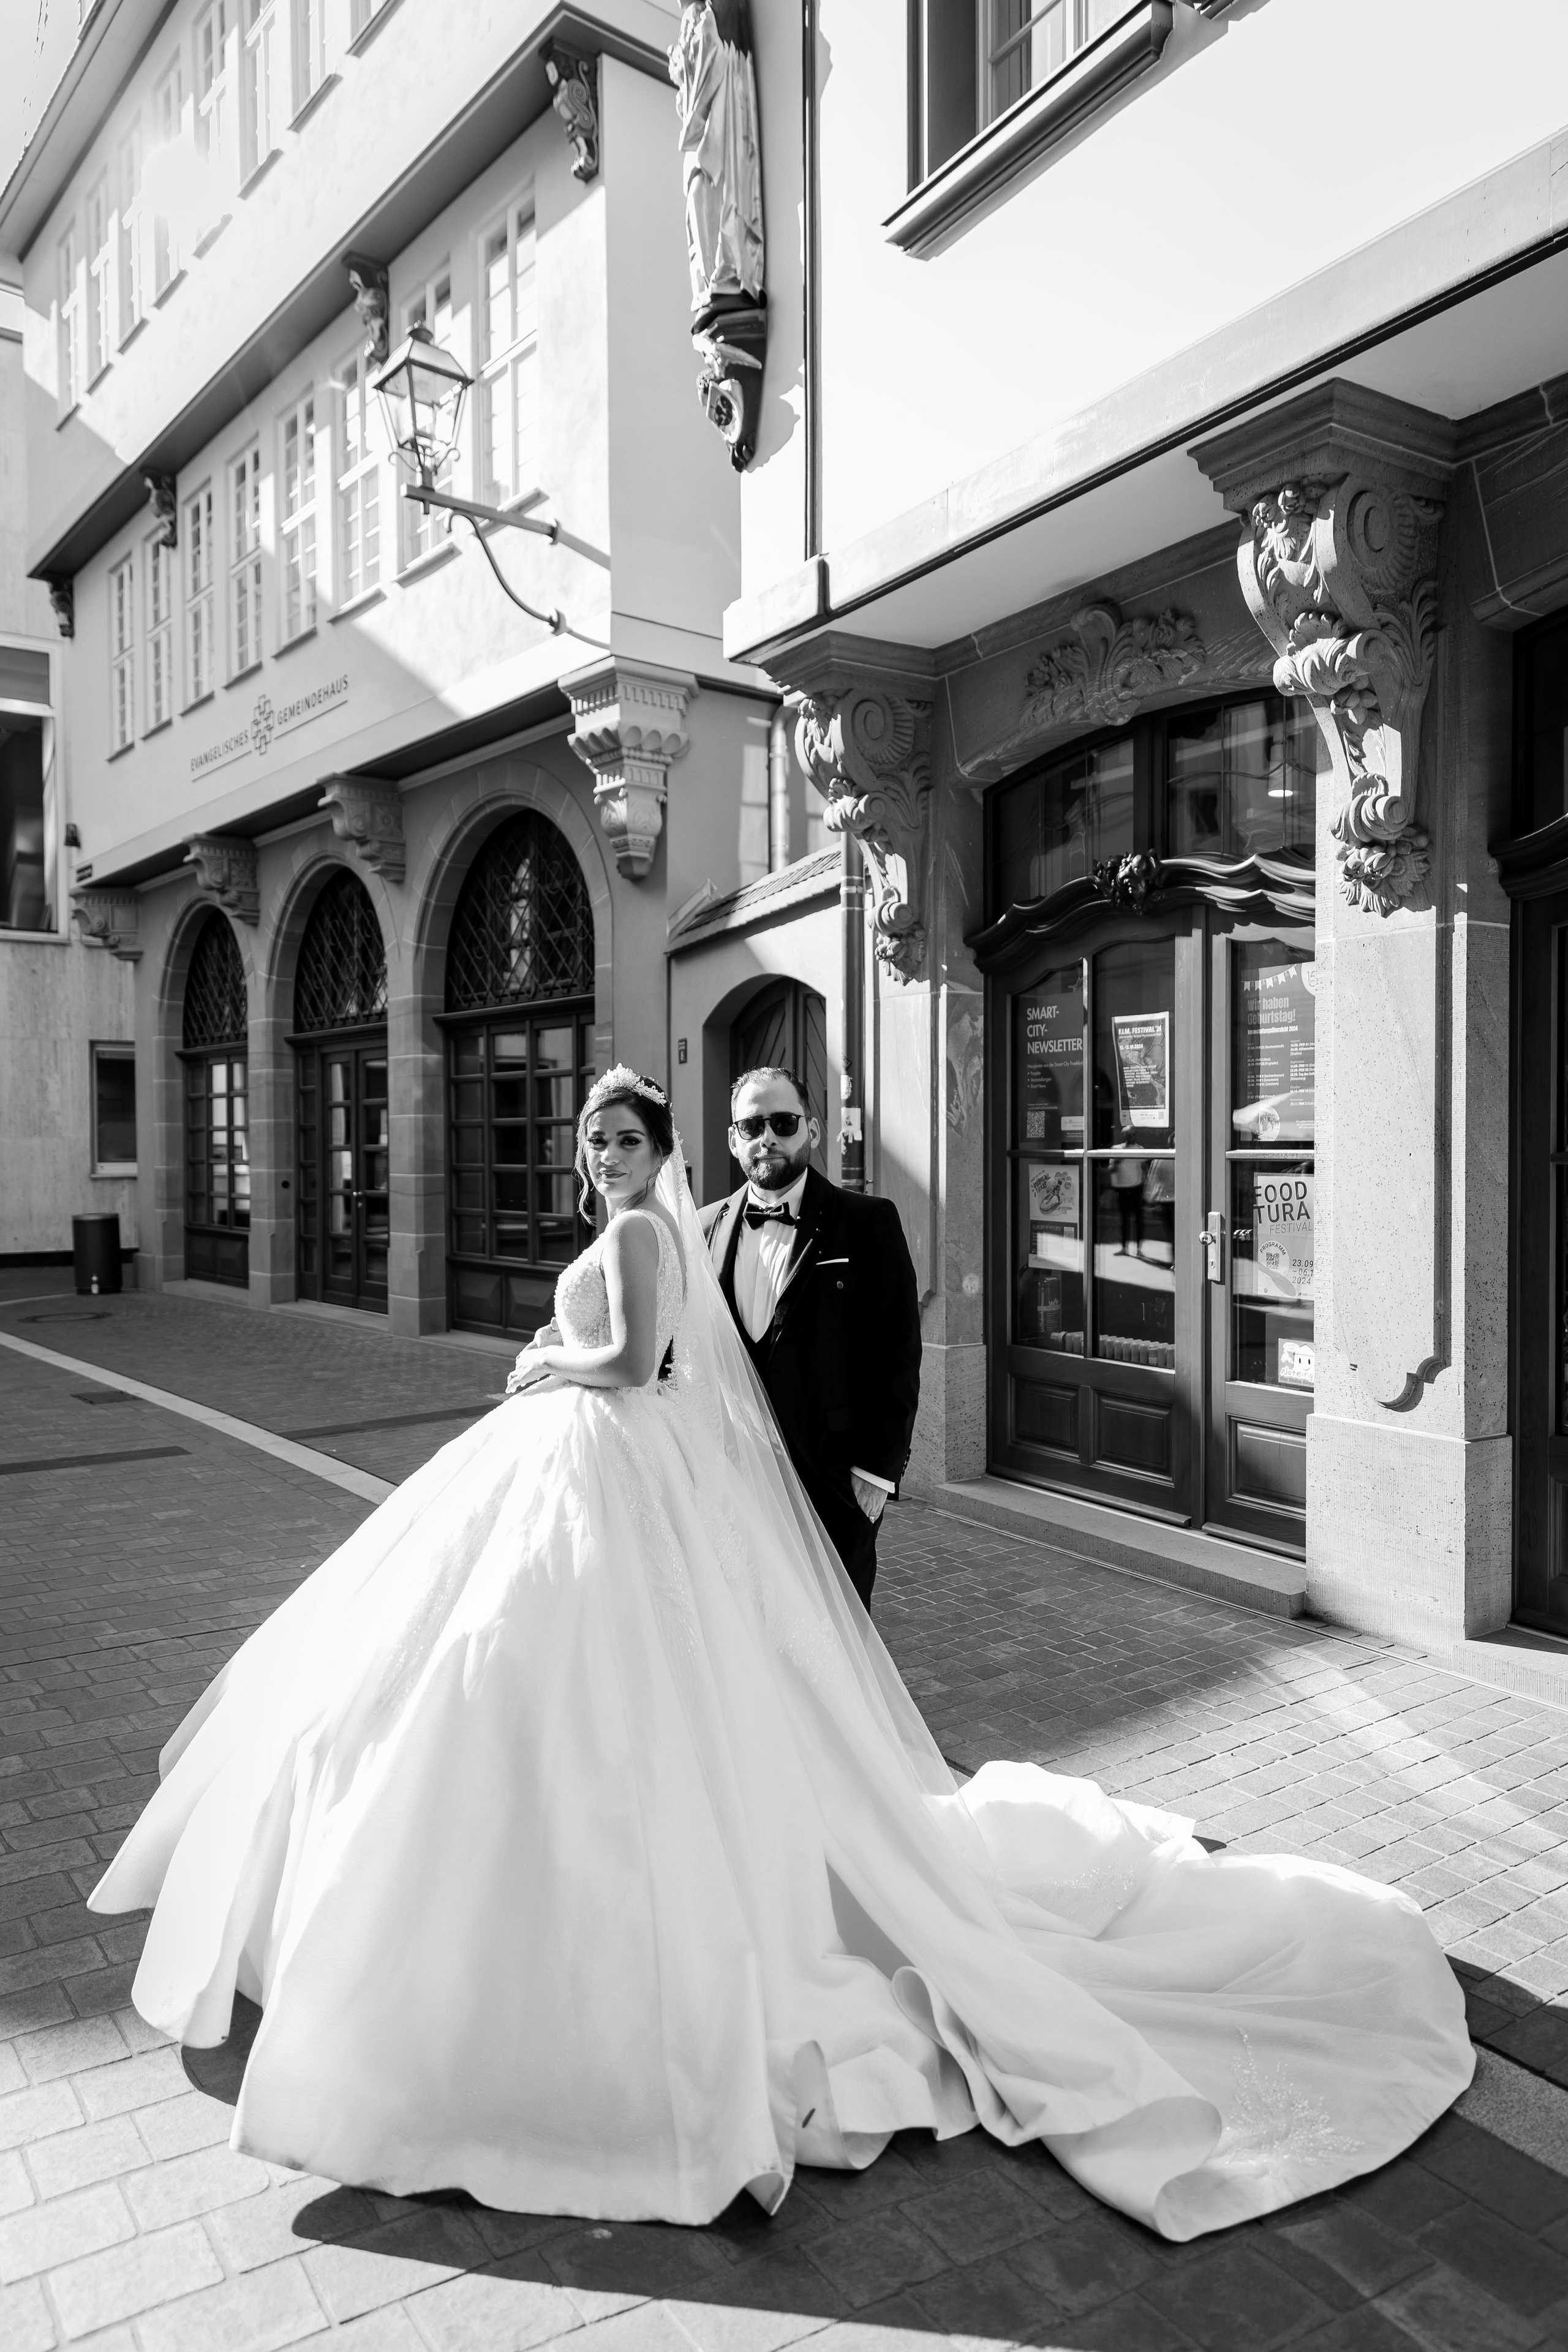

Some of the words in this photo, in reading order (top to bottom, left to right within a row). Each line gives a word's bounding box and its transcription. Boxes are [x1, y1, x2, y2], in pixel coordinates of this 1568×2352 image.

[190, 729, 248, 772] EVANGELISCHES
[277, 674, 348, 725] GEMEINDEHAUS
[1248, 998, 1261, 1011] Wir
[1262, 997, 1289, 1010] haben
[1027, 1005, 1060, 1020] SMART-
[1248, 1009, 1295, 1025] Geburtstag!
[1027, 1023, 1047, 1037] CITY-
[1027, 1038, 1082, 1054] NEWSLETTER
[1253, 1181, 1307, 1205] FOOD
[1253, 1201, 1311, 1224] TURA
[1269, 1221, 1313, 1234] FESTIVAL
[1259, 1242, 1286, 1256] PROGRAMM
[1292, 1276, 1311, 1285] 2024
